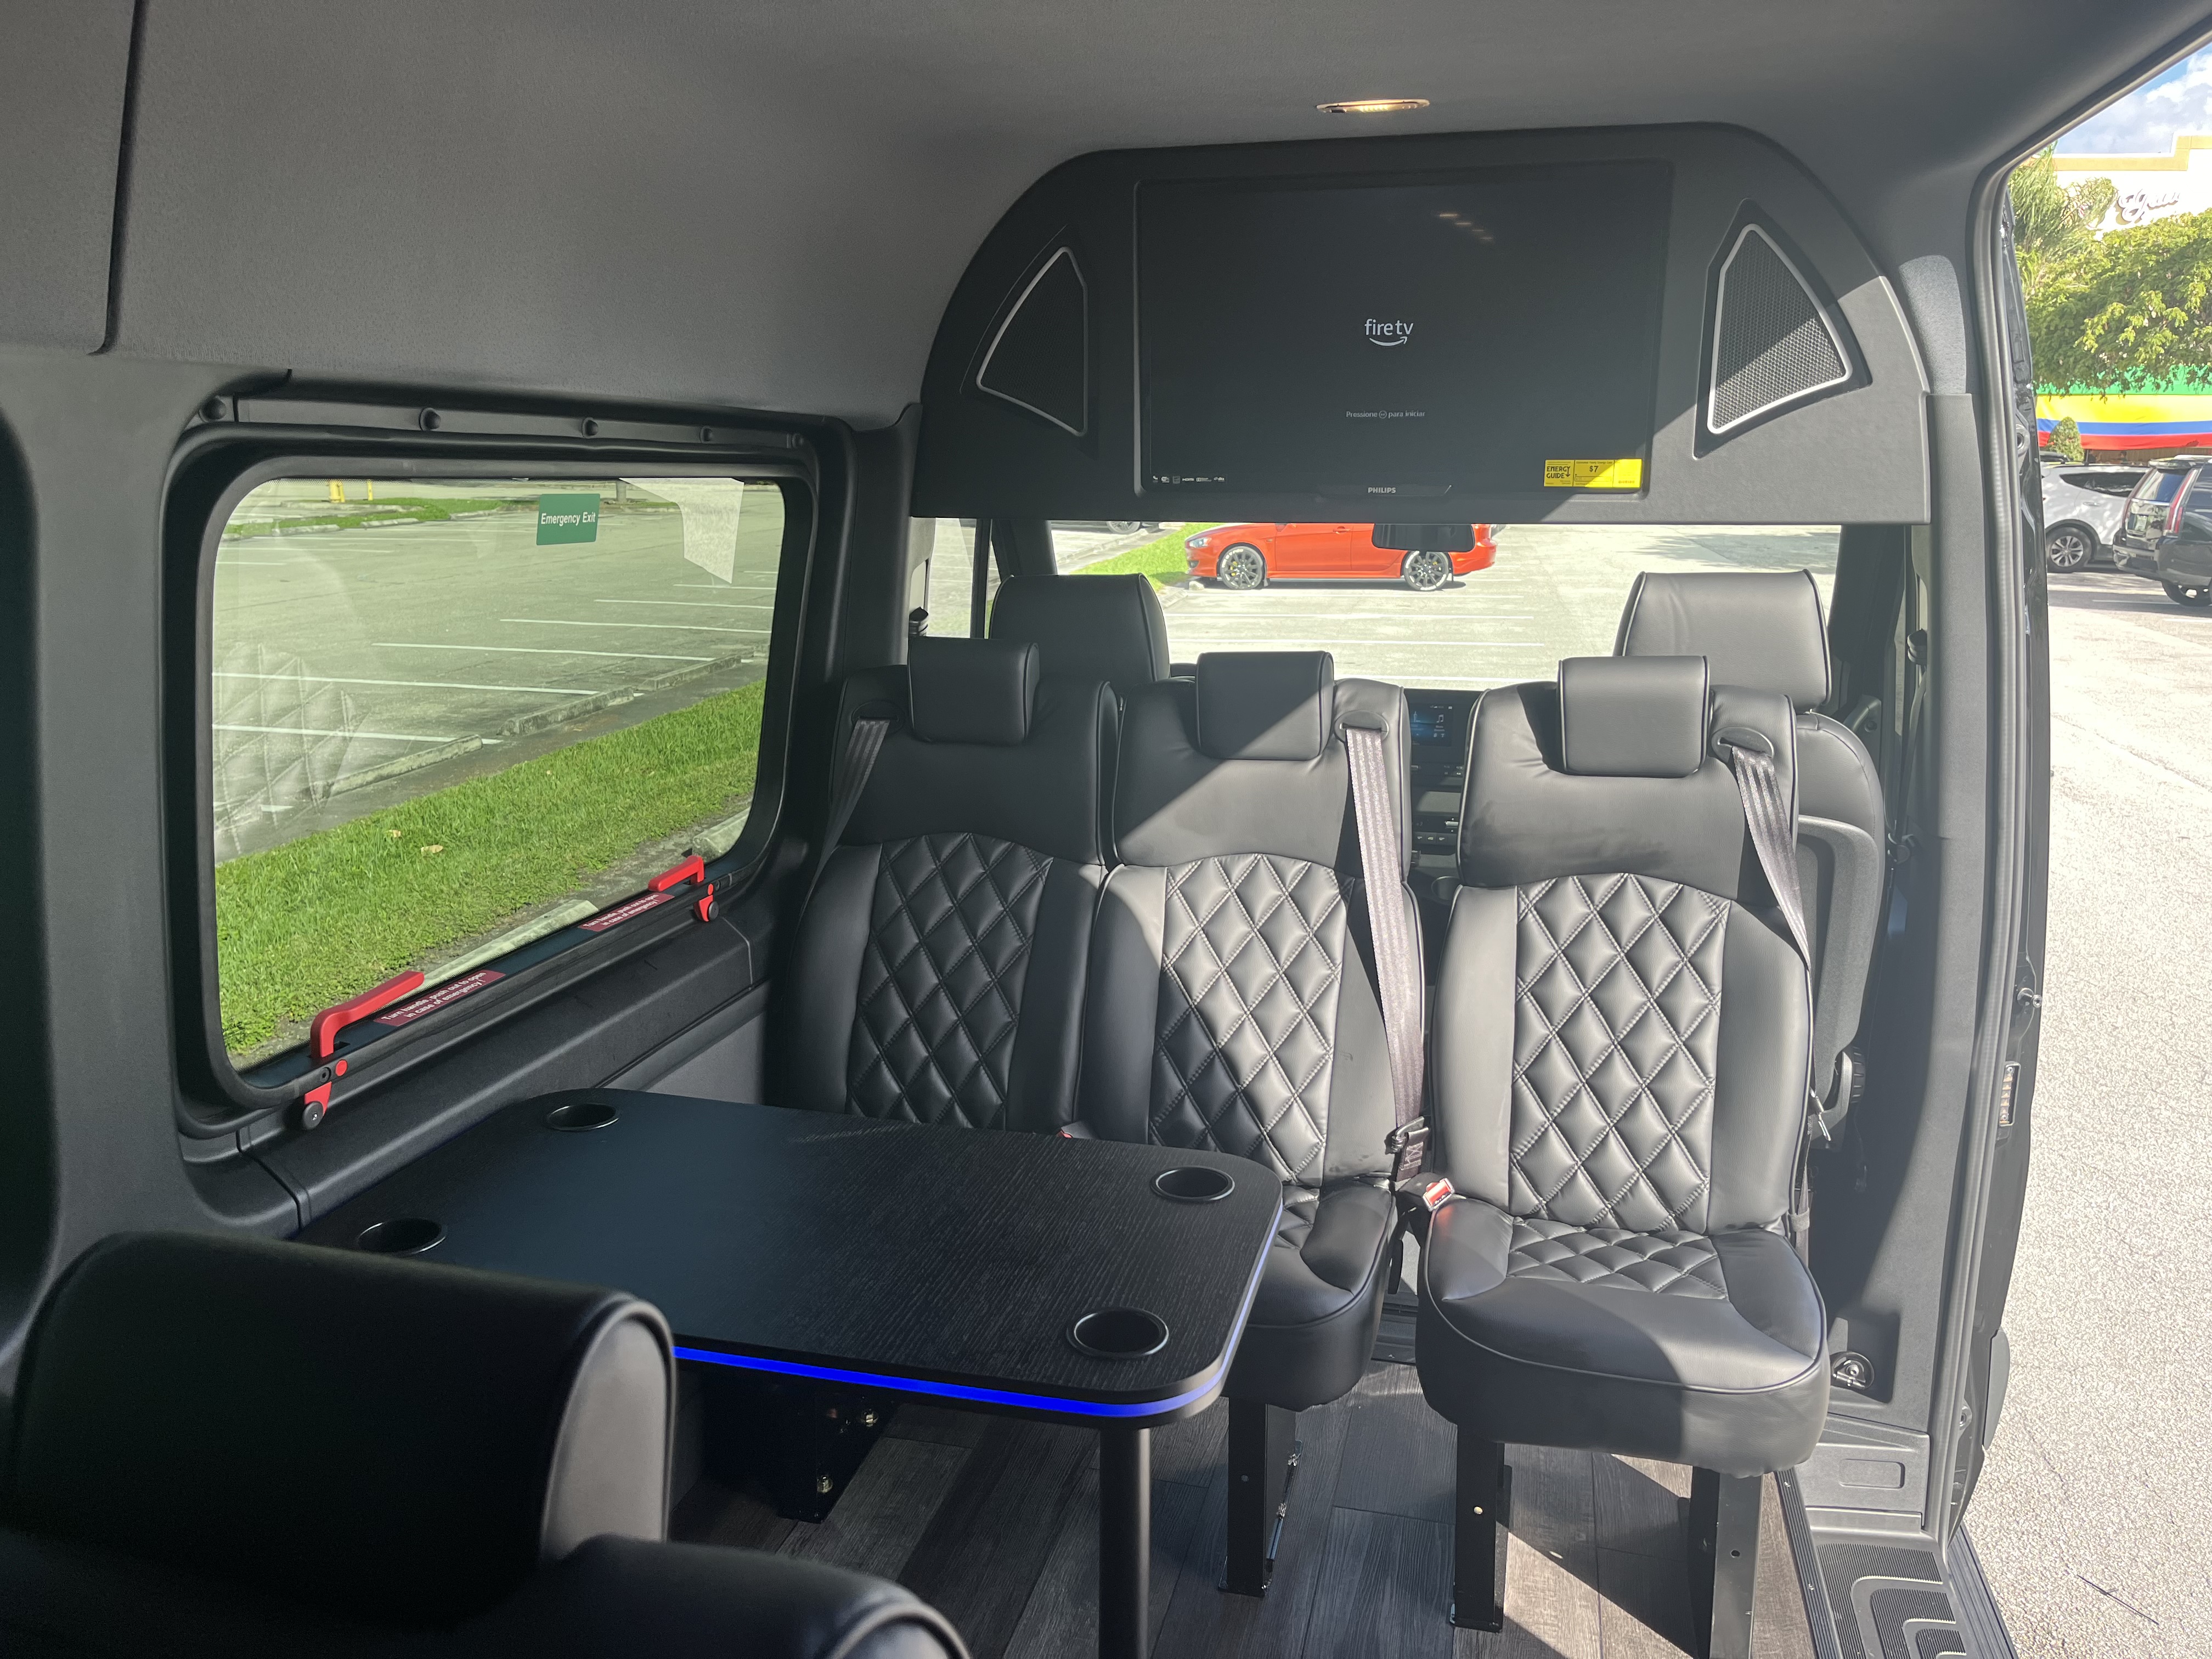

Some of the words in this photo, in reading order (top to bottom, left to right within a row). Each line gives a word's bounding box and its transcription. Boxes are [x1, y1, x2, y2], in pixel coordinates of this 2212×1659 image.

[541, 513, 580, 527] Emergency
[582, 511, 596, 523] Exit
[381, 1011, 405, 1020] Turn
[428, 990, 450, 1000] push
[467, 972, 487, 981] open
[415, 1004, 435, 1013] case
